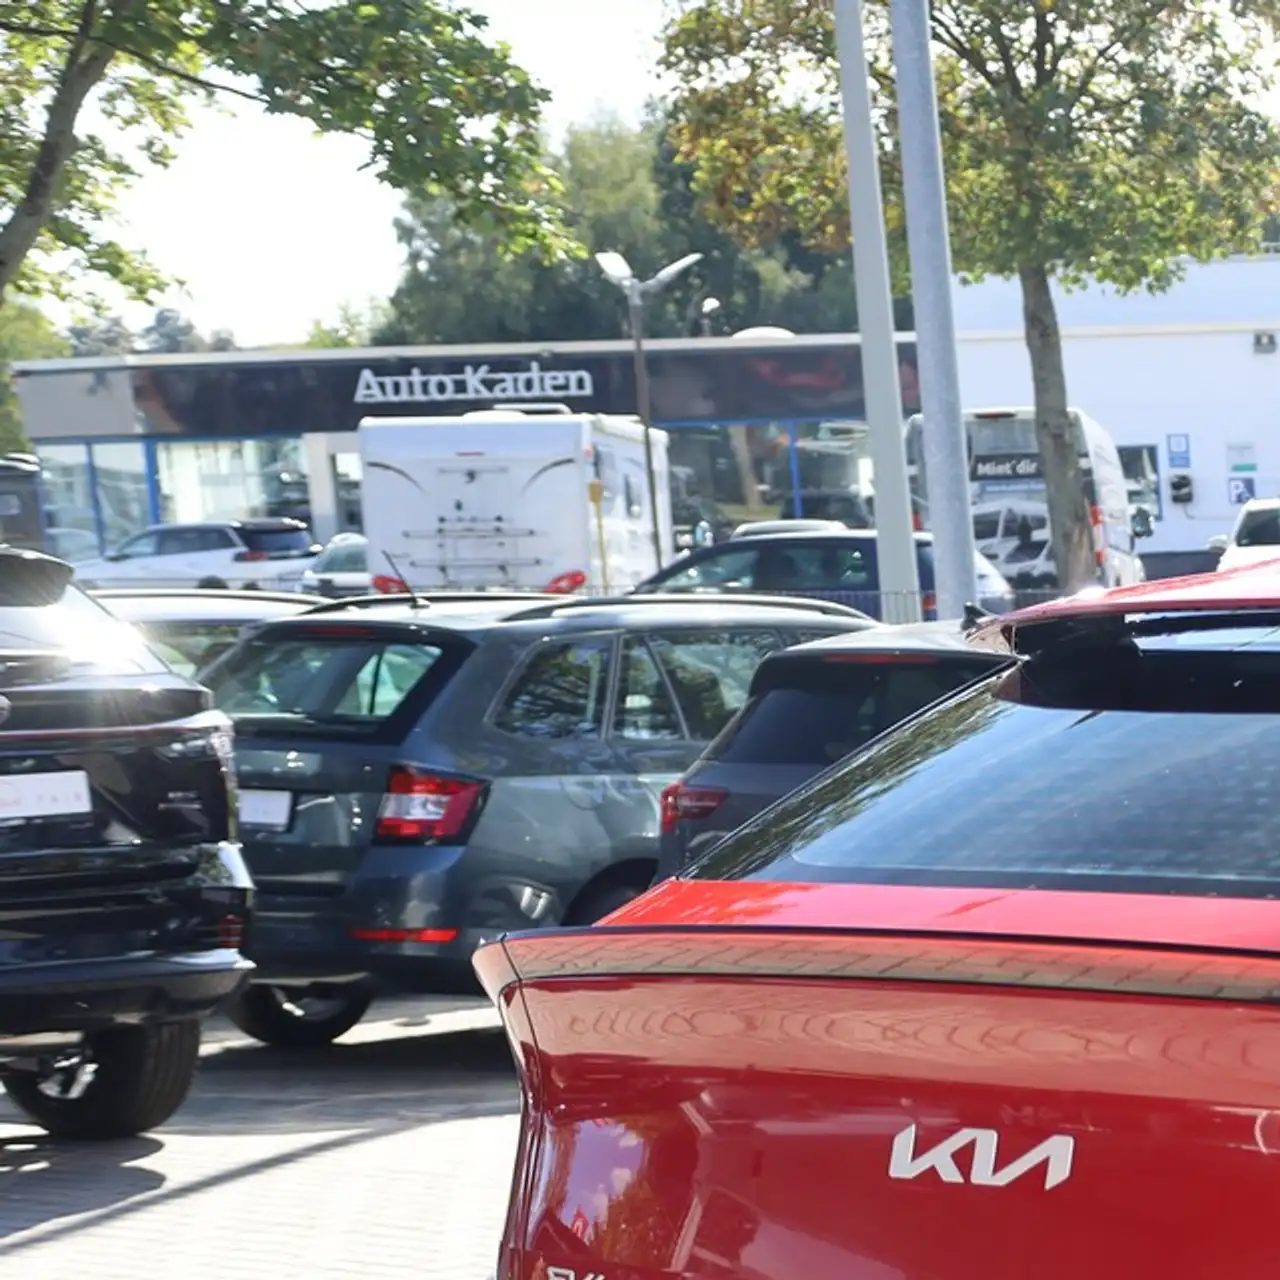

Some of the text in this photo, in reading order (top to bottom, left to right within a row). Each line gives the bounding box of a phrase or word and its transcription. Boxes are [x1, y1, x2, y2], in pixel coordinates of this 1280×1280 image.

[353, 361, 594, 403] Auto Kaden
[888, 1123, 1075, 1191] KIA
